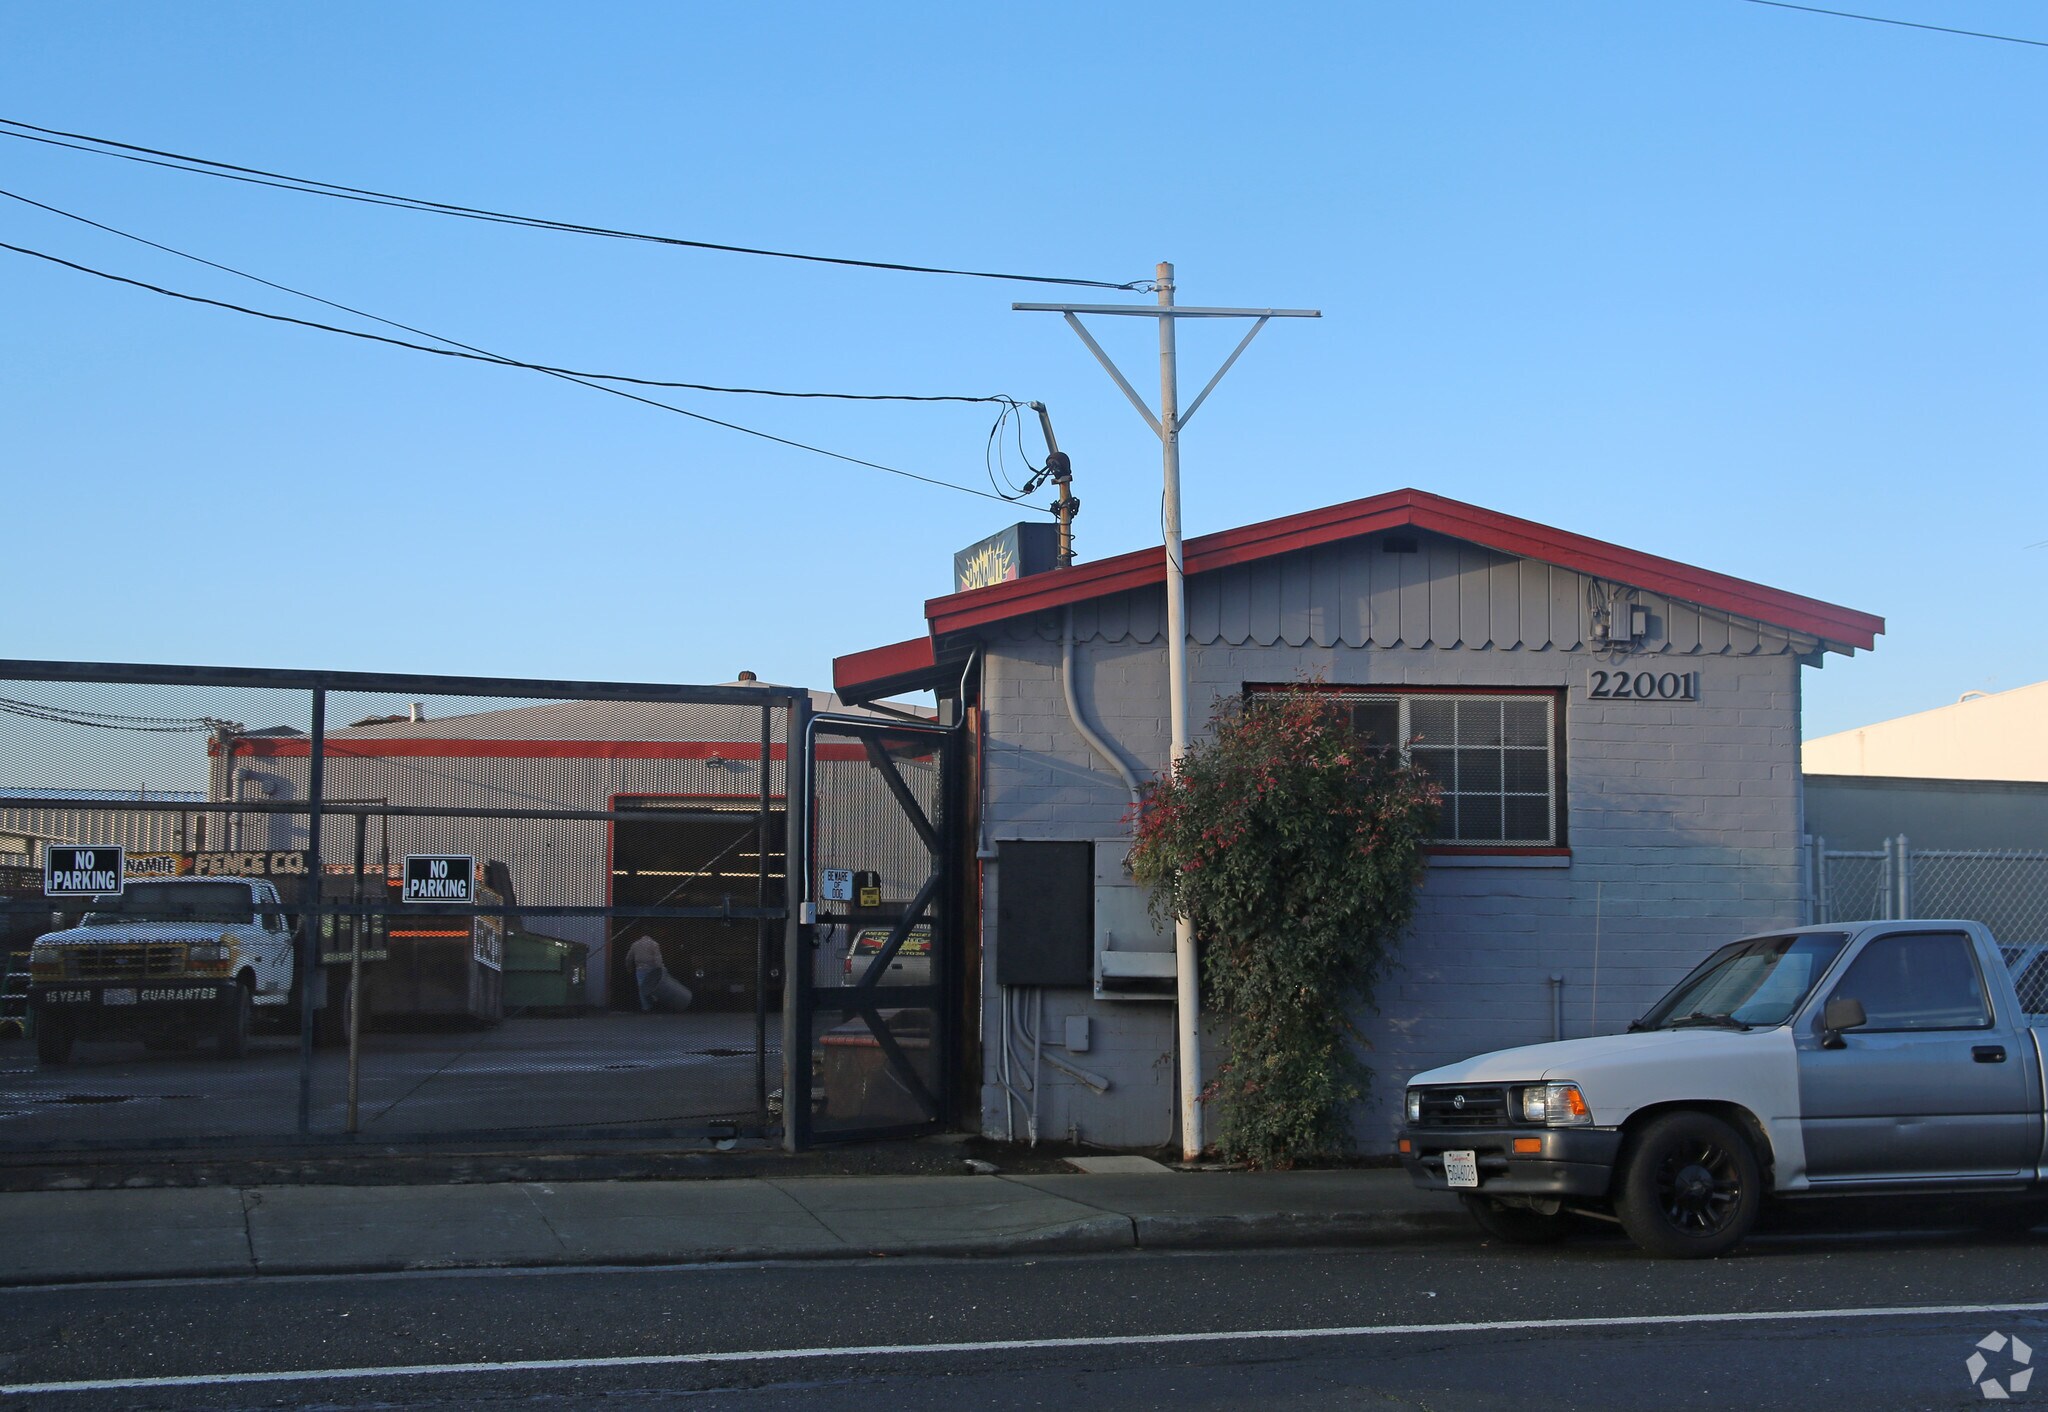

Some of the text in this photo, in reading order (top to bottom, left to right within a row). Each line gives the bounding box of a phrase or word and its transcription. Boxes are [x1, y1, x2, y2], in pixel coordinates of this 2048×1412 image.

[1591, 670, 1694, 699] 22001
[75, 850, 95, 870] NO
[125, 851, 309, 875] NAMITE FENCE CO.
[430, 860, 448, 879] NO
[53, 870, 116, 890] PARKING
[828, 871, 848, 882] BEWARE
[833, 881, 841, 889] OF
[410, 879, 467, 898] PARKING
[831, 888, 843, 899] DOG
[46, 991, 57, 1003] 15
[59, 990, 92, 1003] YEAR
[140, 987, 218, 1001] GUARANTEE
